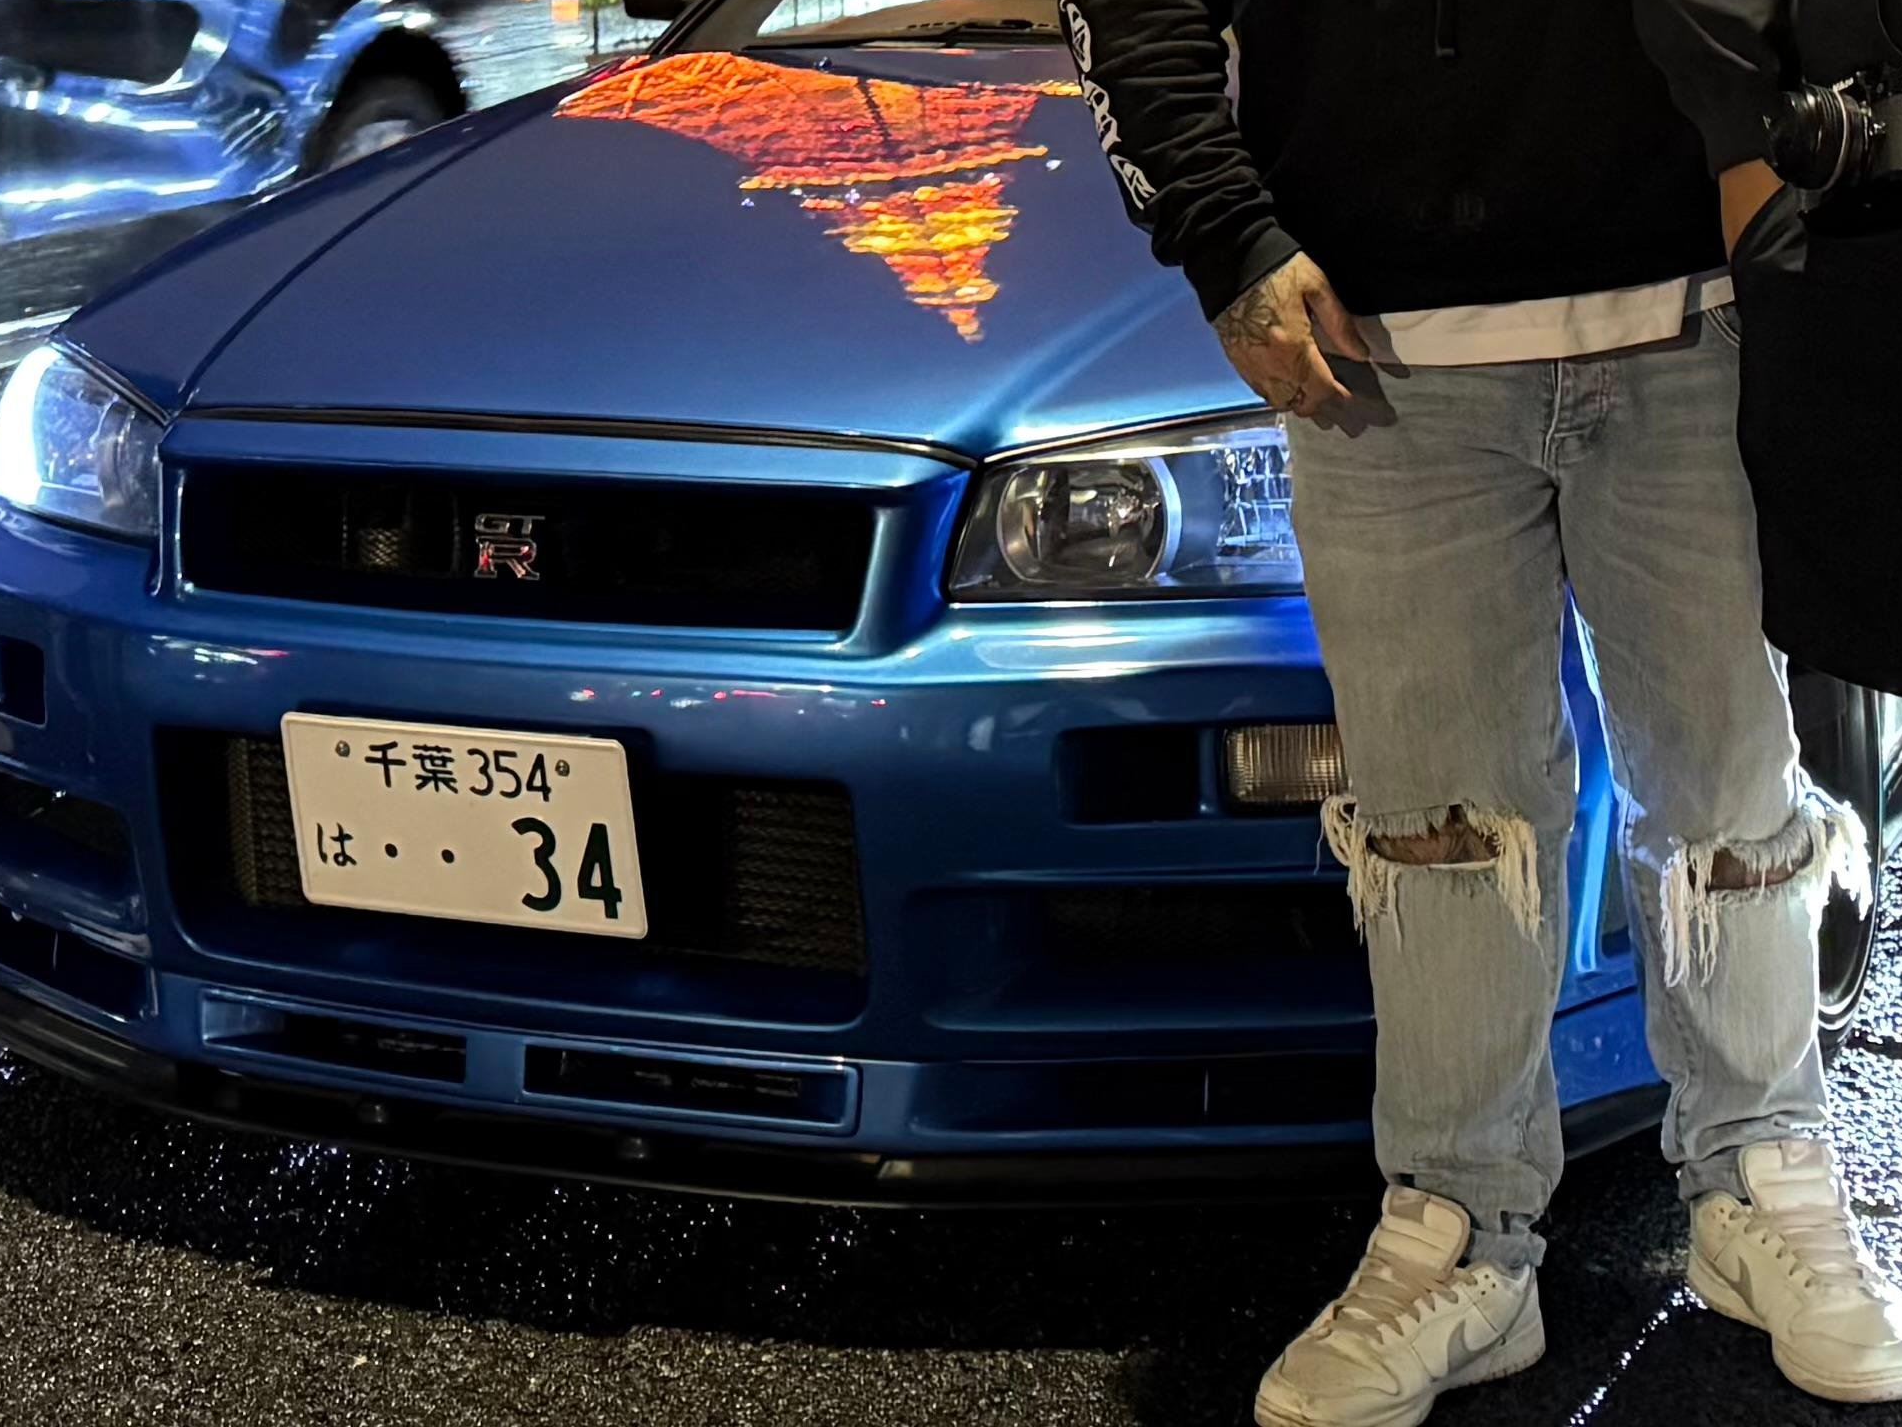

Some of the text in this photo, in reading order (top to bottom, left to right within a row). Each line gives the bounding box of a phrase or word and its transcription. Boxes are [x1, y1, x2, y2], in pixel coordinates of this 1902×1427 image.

[474, 535, 540, 580] R
[467, 747, 552, 802] 354
[511, 817, 623, 920] 34
